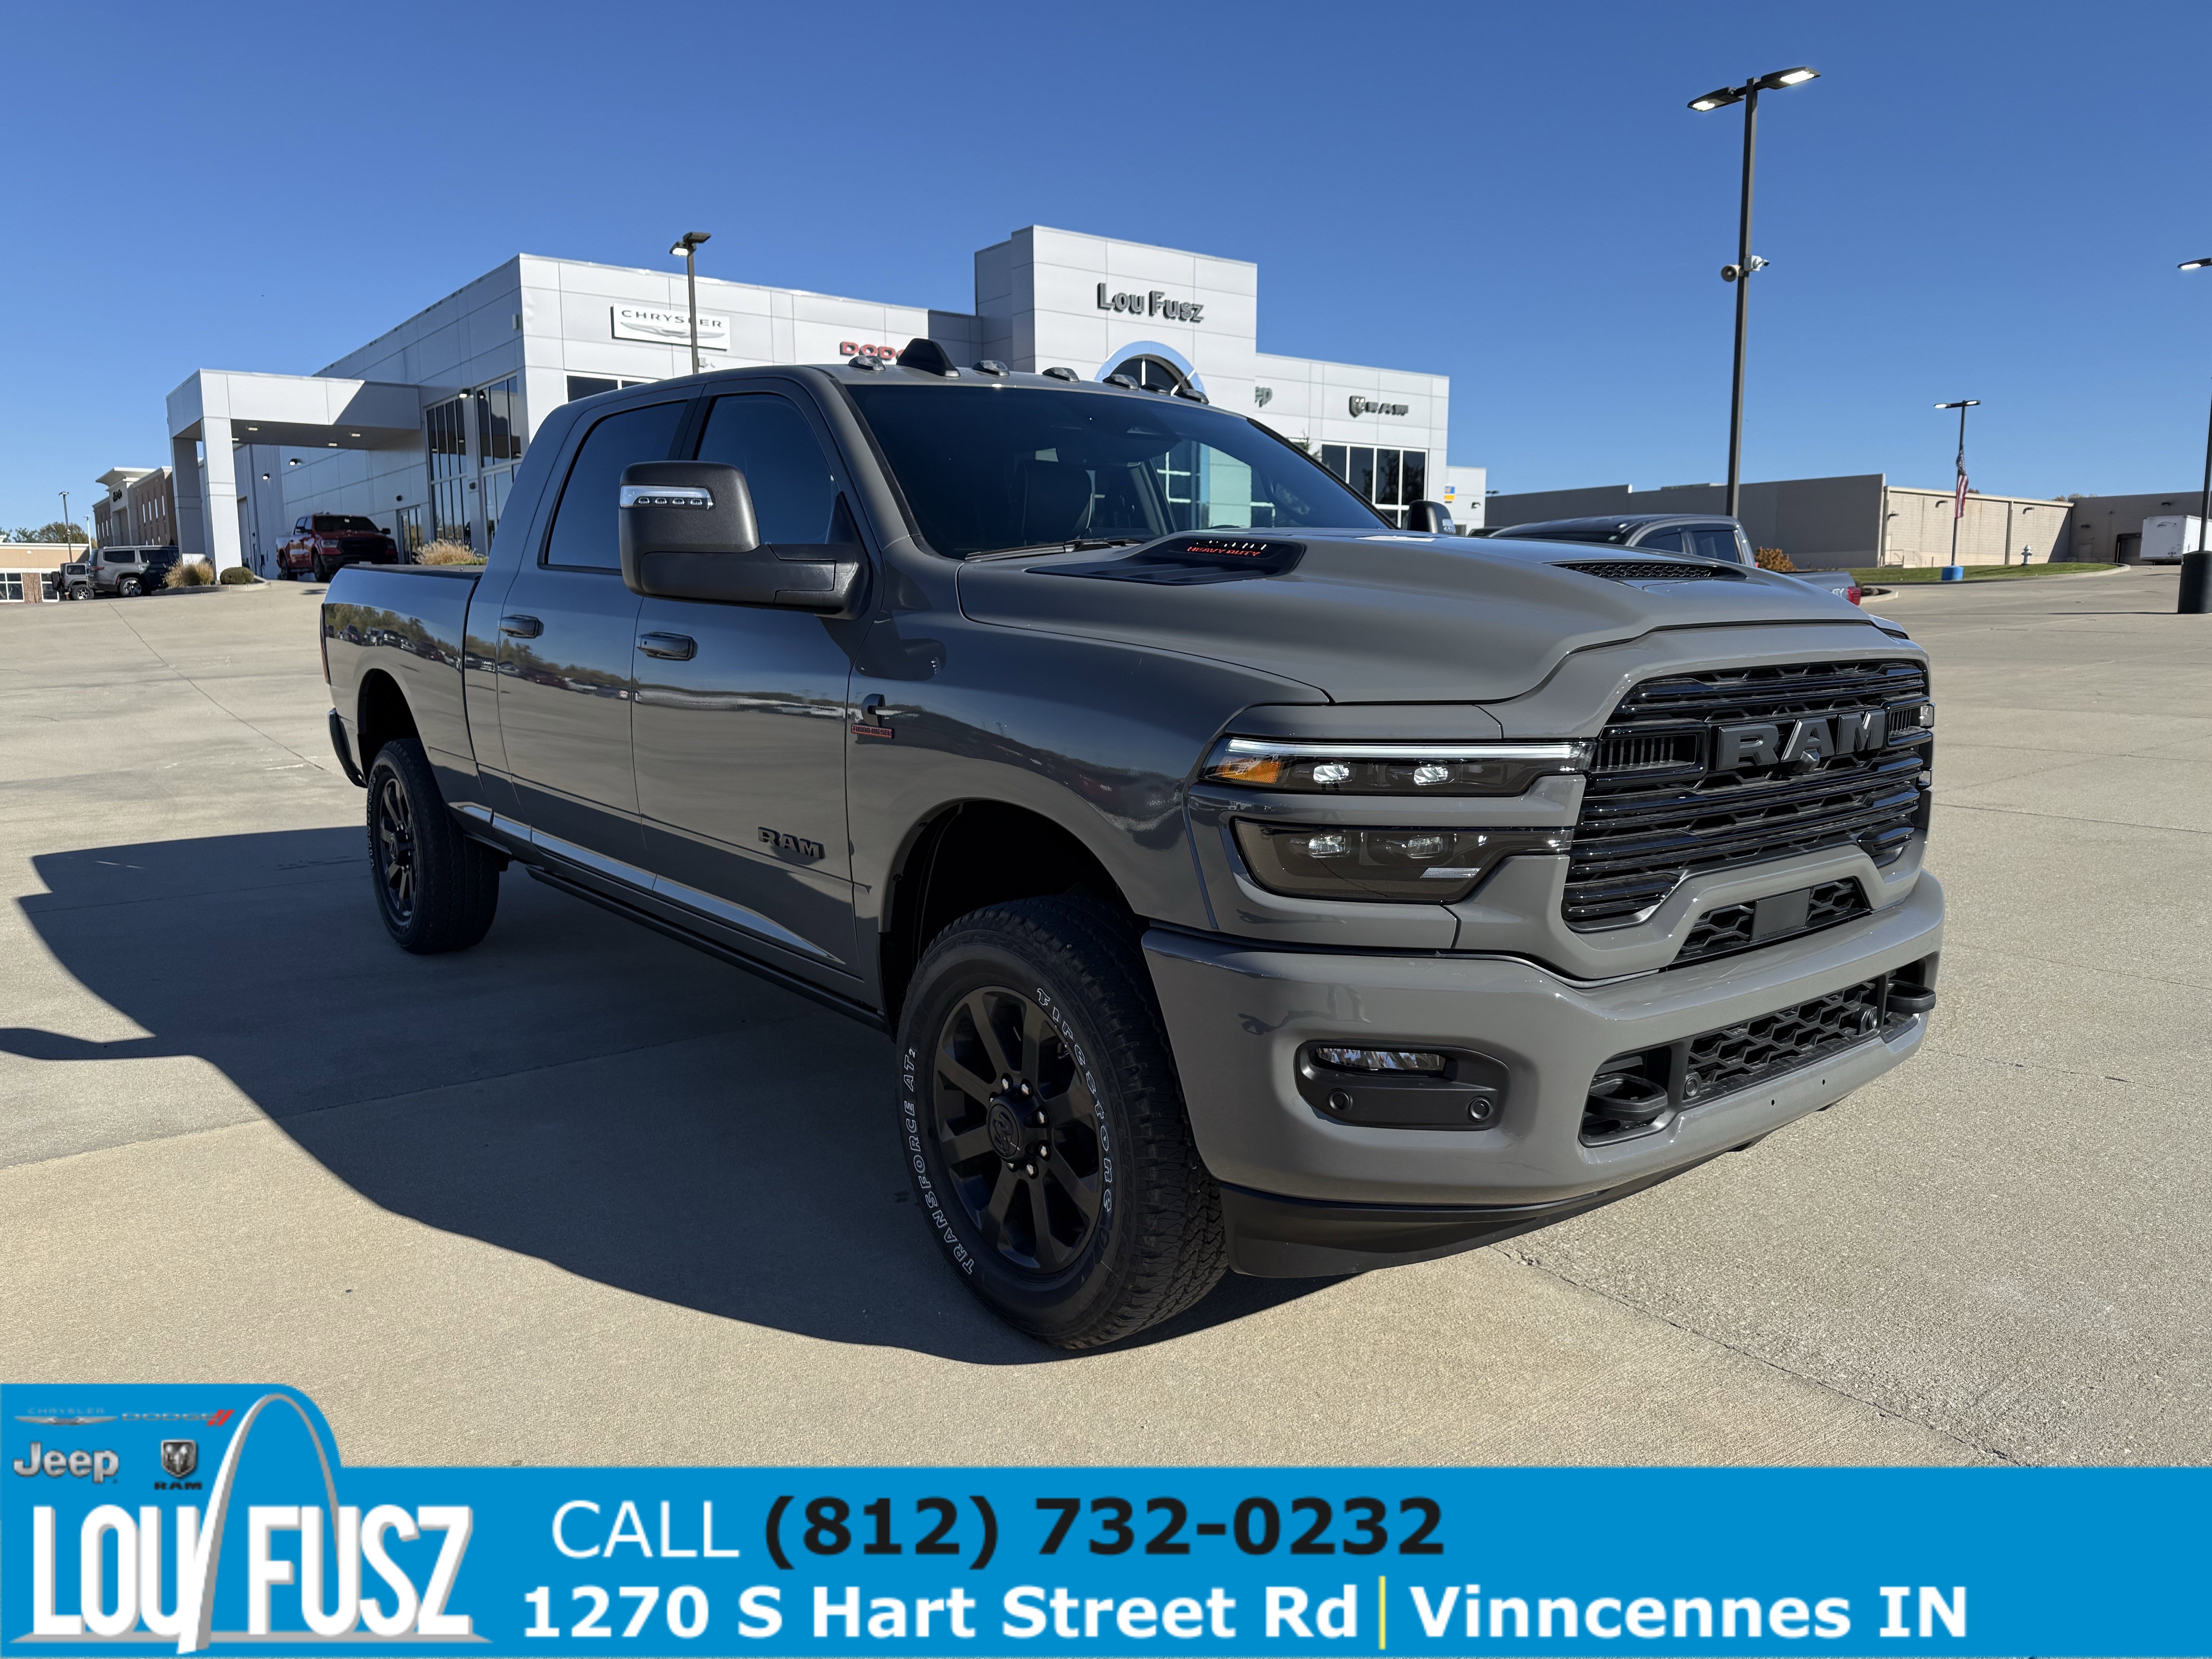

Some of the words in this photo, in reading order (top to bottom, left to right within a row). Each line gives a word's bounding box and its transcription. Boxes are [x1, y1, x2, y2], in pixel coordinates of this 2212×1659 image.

[621, 310, 722, 328] CHRYSER
[1097, 282, 1145, 314] Lou
[1149, 290, 1204, 323] Fusz
[840, 342, 905, 361] DOD
[1365, 402, 1409, 416] RAM
[1716, 709, 1886, 770] RAM
[758, 826, 826, 859] RAM
[1037, 988, 1112, 1212] Firestone
[905, 1100, 975, 1275] TRANSFORCE
